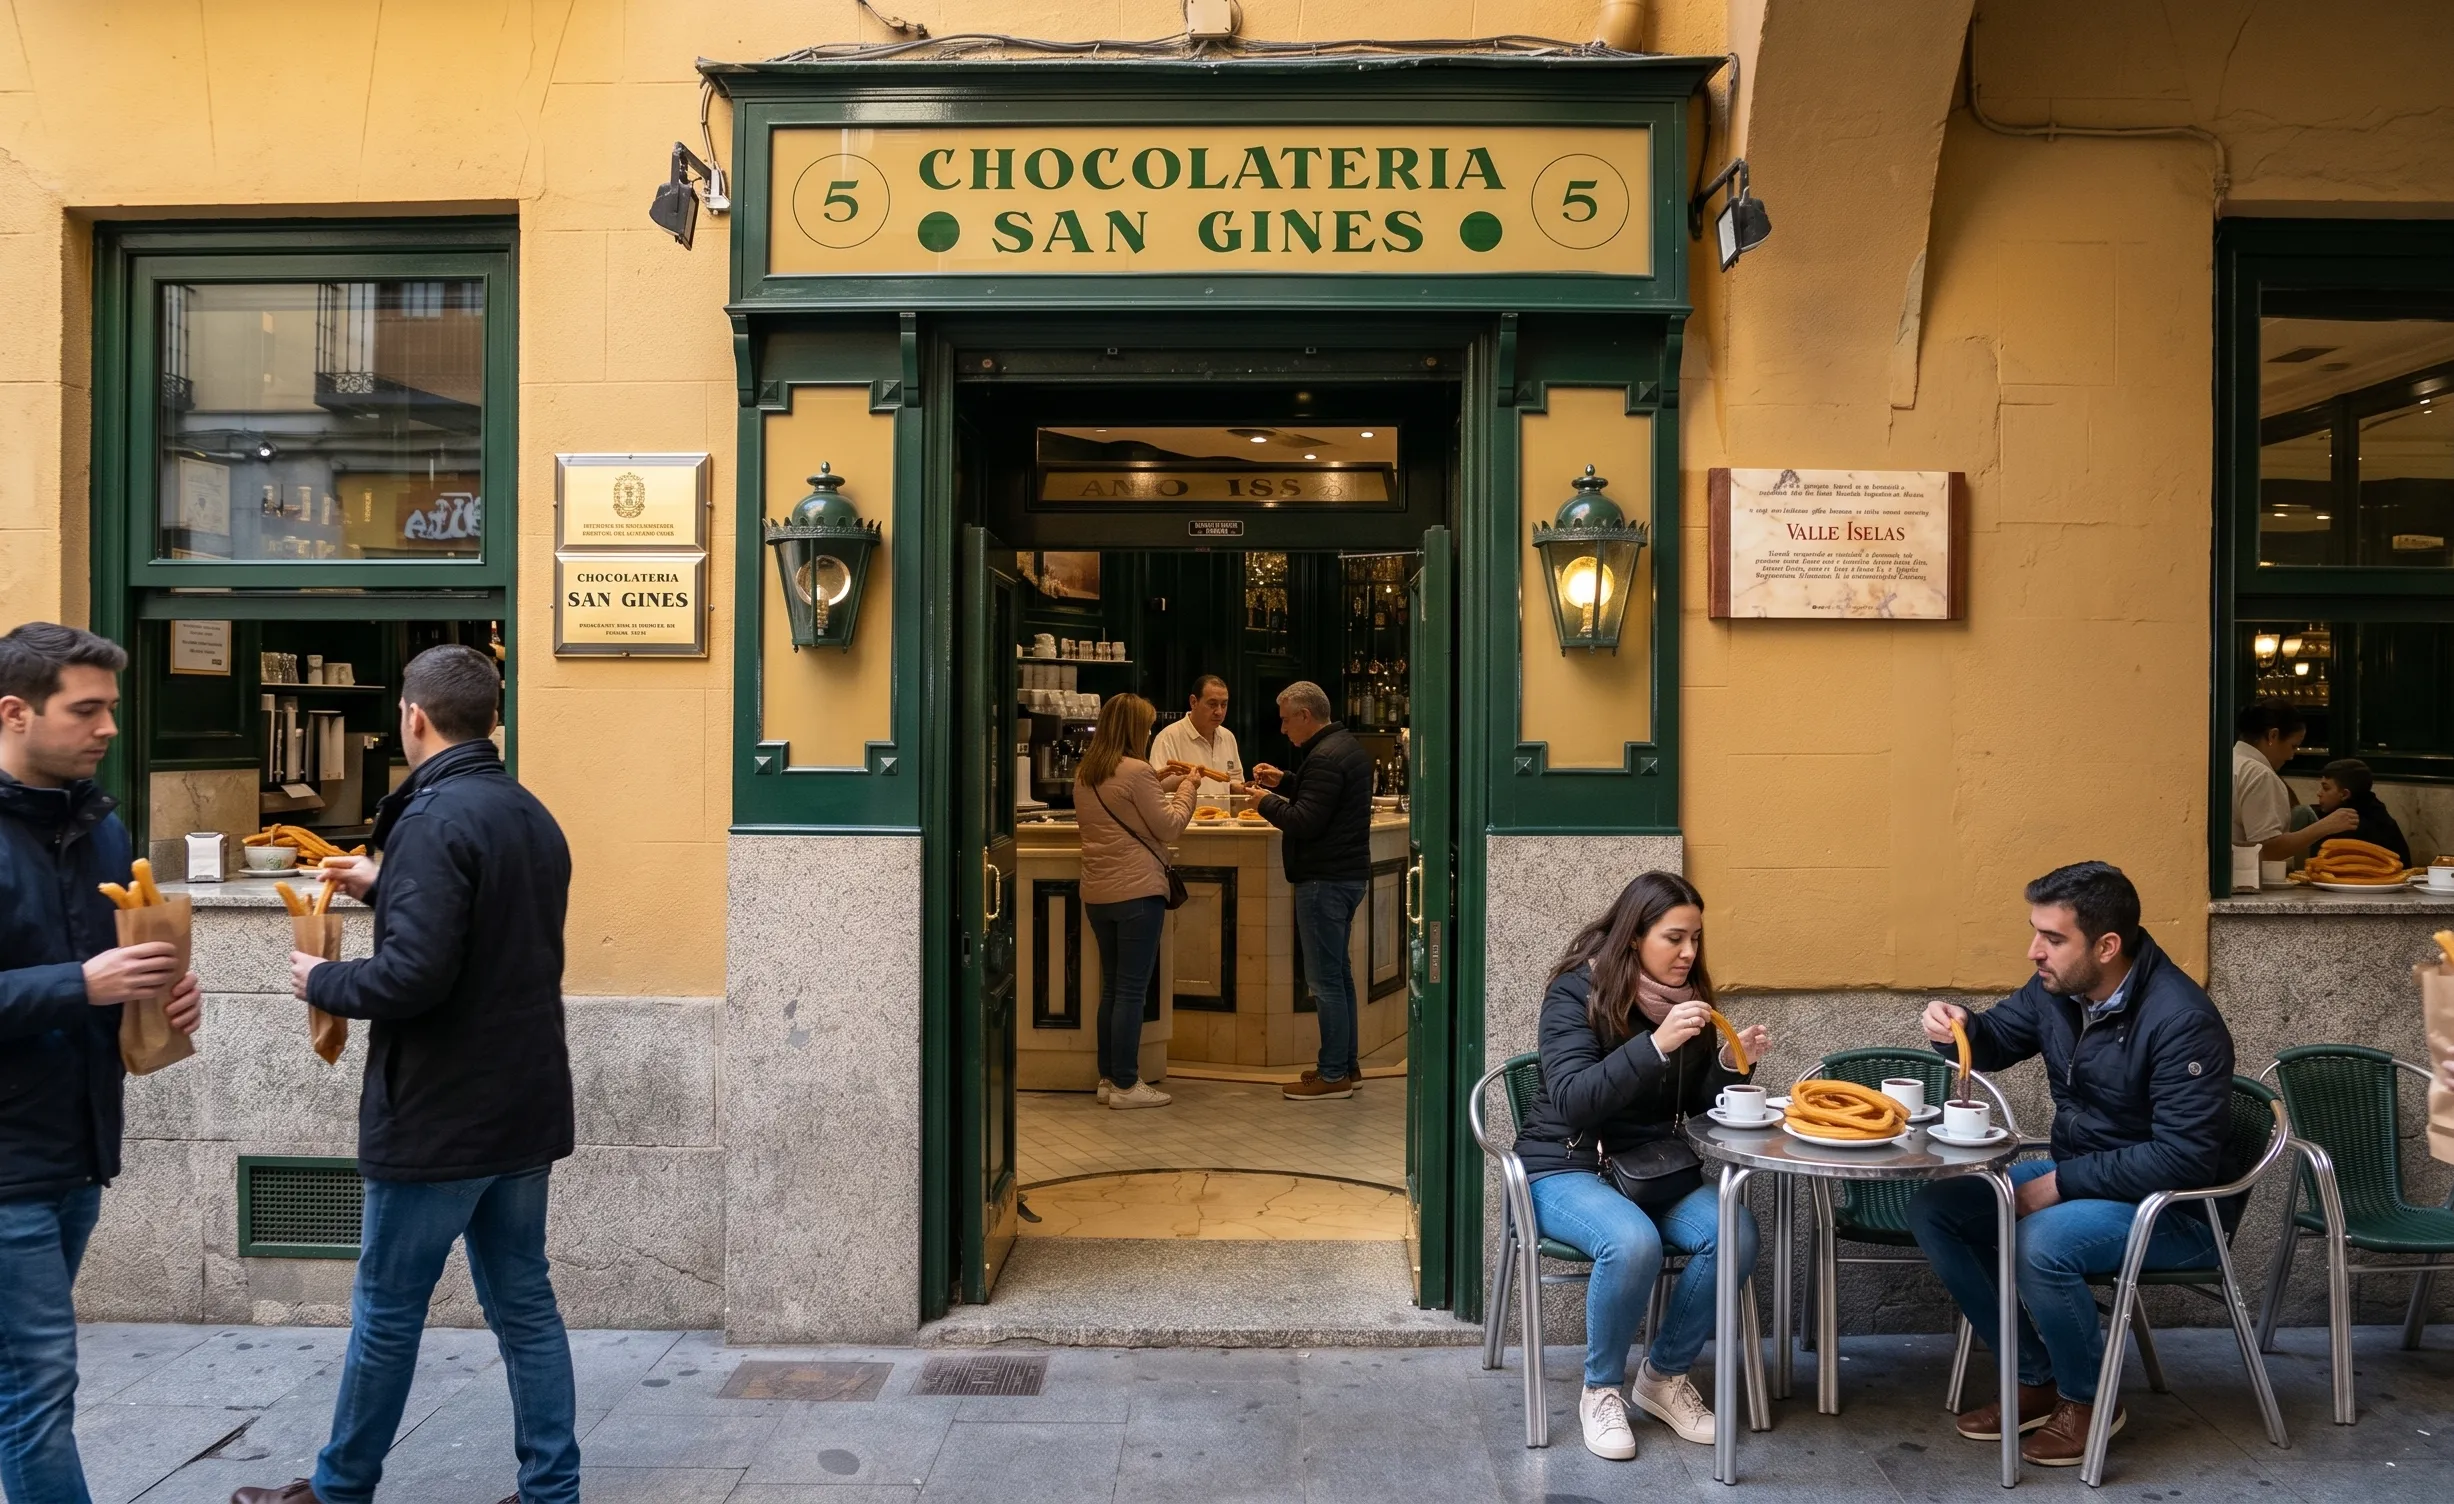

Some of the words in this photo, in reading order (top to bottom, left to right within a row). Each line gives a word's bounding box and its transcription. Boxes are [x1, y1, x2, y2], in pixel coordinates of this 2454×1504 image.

[918, 146, 1507, 191] CHOCOLATERIA
[823, 179, 859, 223] 5
[1562, 179, 1598, 223] 5
[991, 209, 1149, 254] SAN
[1197, 208, 1424, 254] GINES
[1786, 523, 1840, 541] VALLE
[1846, 520, 1906, 542] ISELAS
[567, 591, 611, 608] SAN
[621, 591, 689, 608] GINES
[577, 573, 679, 583] CHOCOLATERIA
